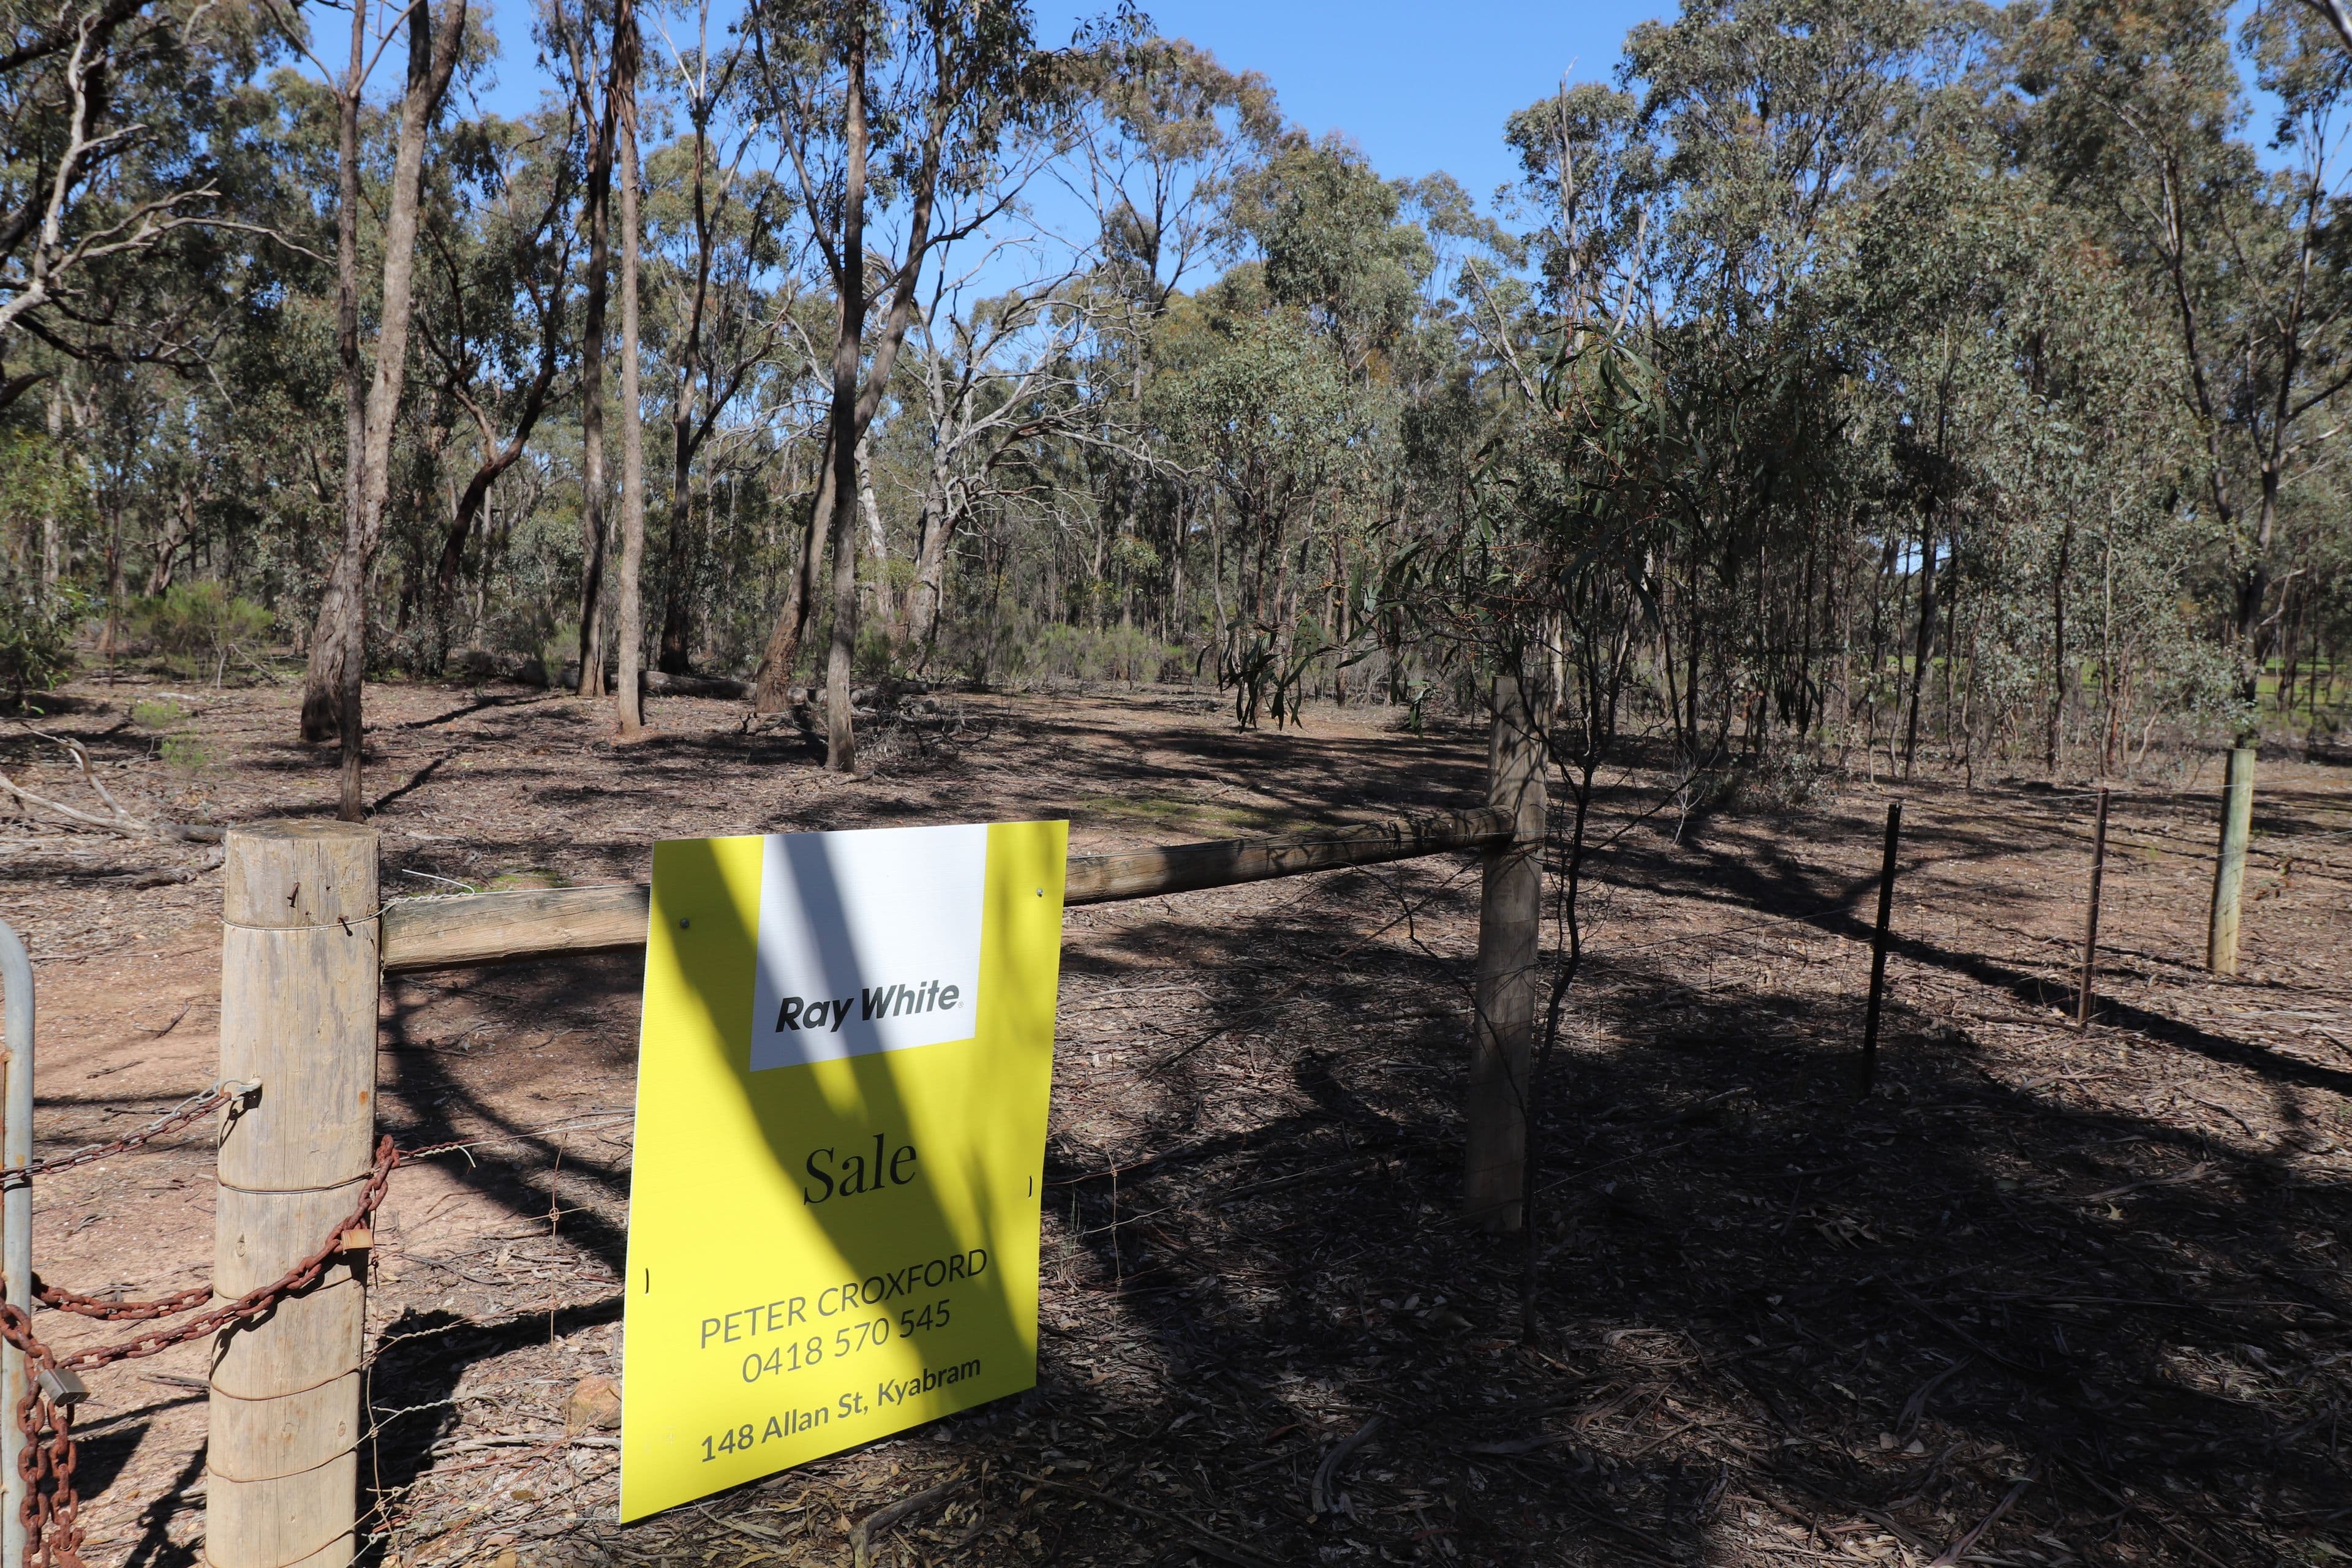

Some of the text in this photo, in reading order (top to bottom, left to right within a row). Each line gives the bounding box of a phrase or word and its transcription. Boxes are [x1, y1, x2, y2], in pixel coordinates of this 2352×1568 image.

[775, 980, 960, 1032] Ray White
[804, 1133, 916, 1205] Sale
[701, 1248, 987, 1349] PETER CROXFORD
[742, 1299, 951, 1383] 0418 570 545
[701, 1359, 980, 1463] 148 Allan St, Kyabram
